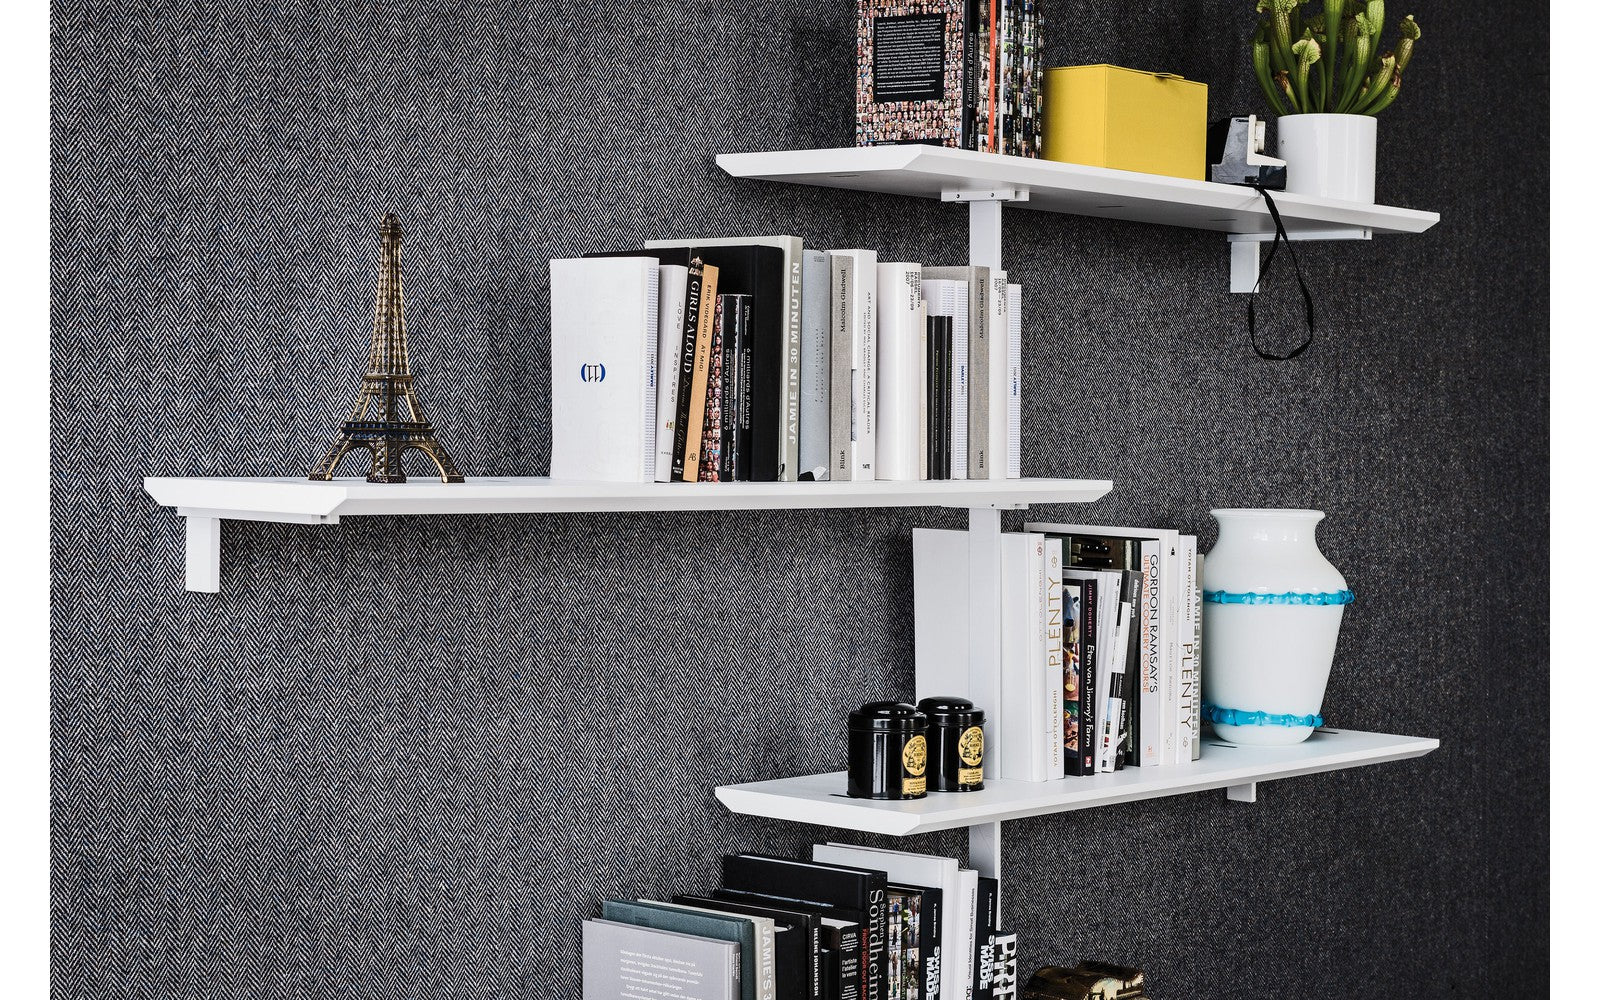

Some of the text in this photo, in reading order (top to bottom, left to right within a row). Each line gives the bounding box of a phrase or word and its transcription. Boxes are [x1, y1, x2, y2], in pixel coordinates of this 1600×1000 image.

[967, 32, 975, 67] d'Autres
[966, 102, 974, 110] 6
[683, 280, 700, 373] GIRLS ALOUD
[581, 363, 605, 383] (11)
[670, 345, 680, 403] INSPIRES
[787, 262, 800, 445] JAMIE IN 30 MINUTEN
[1048, 576, 1061, 667] PLENTY
[1150, 554, 1158, 693] GORDON RAMSAY'S
[1193, 634, 1200, 650] IN
[1086, 644, 1095, 667] Eten
[1142, 653, 1150, 693] COURSE
[1084, 685, 1094, 722] Jimmy's
[1181, 643, 1193, 728] PLENTY
[1085, 724, 1094, 747] Farm
[878, 903, 886, 938] Stephen
[762, 926, 772, 990] JAMIE'S
[869, 889, 885, 1000] Sondheim
[926, 956, 935, 1000] MADE
[933, 946, 941, 995] SWISS
[979, 945, 989, 990] MADE
